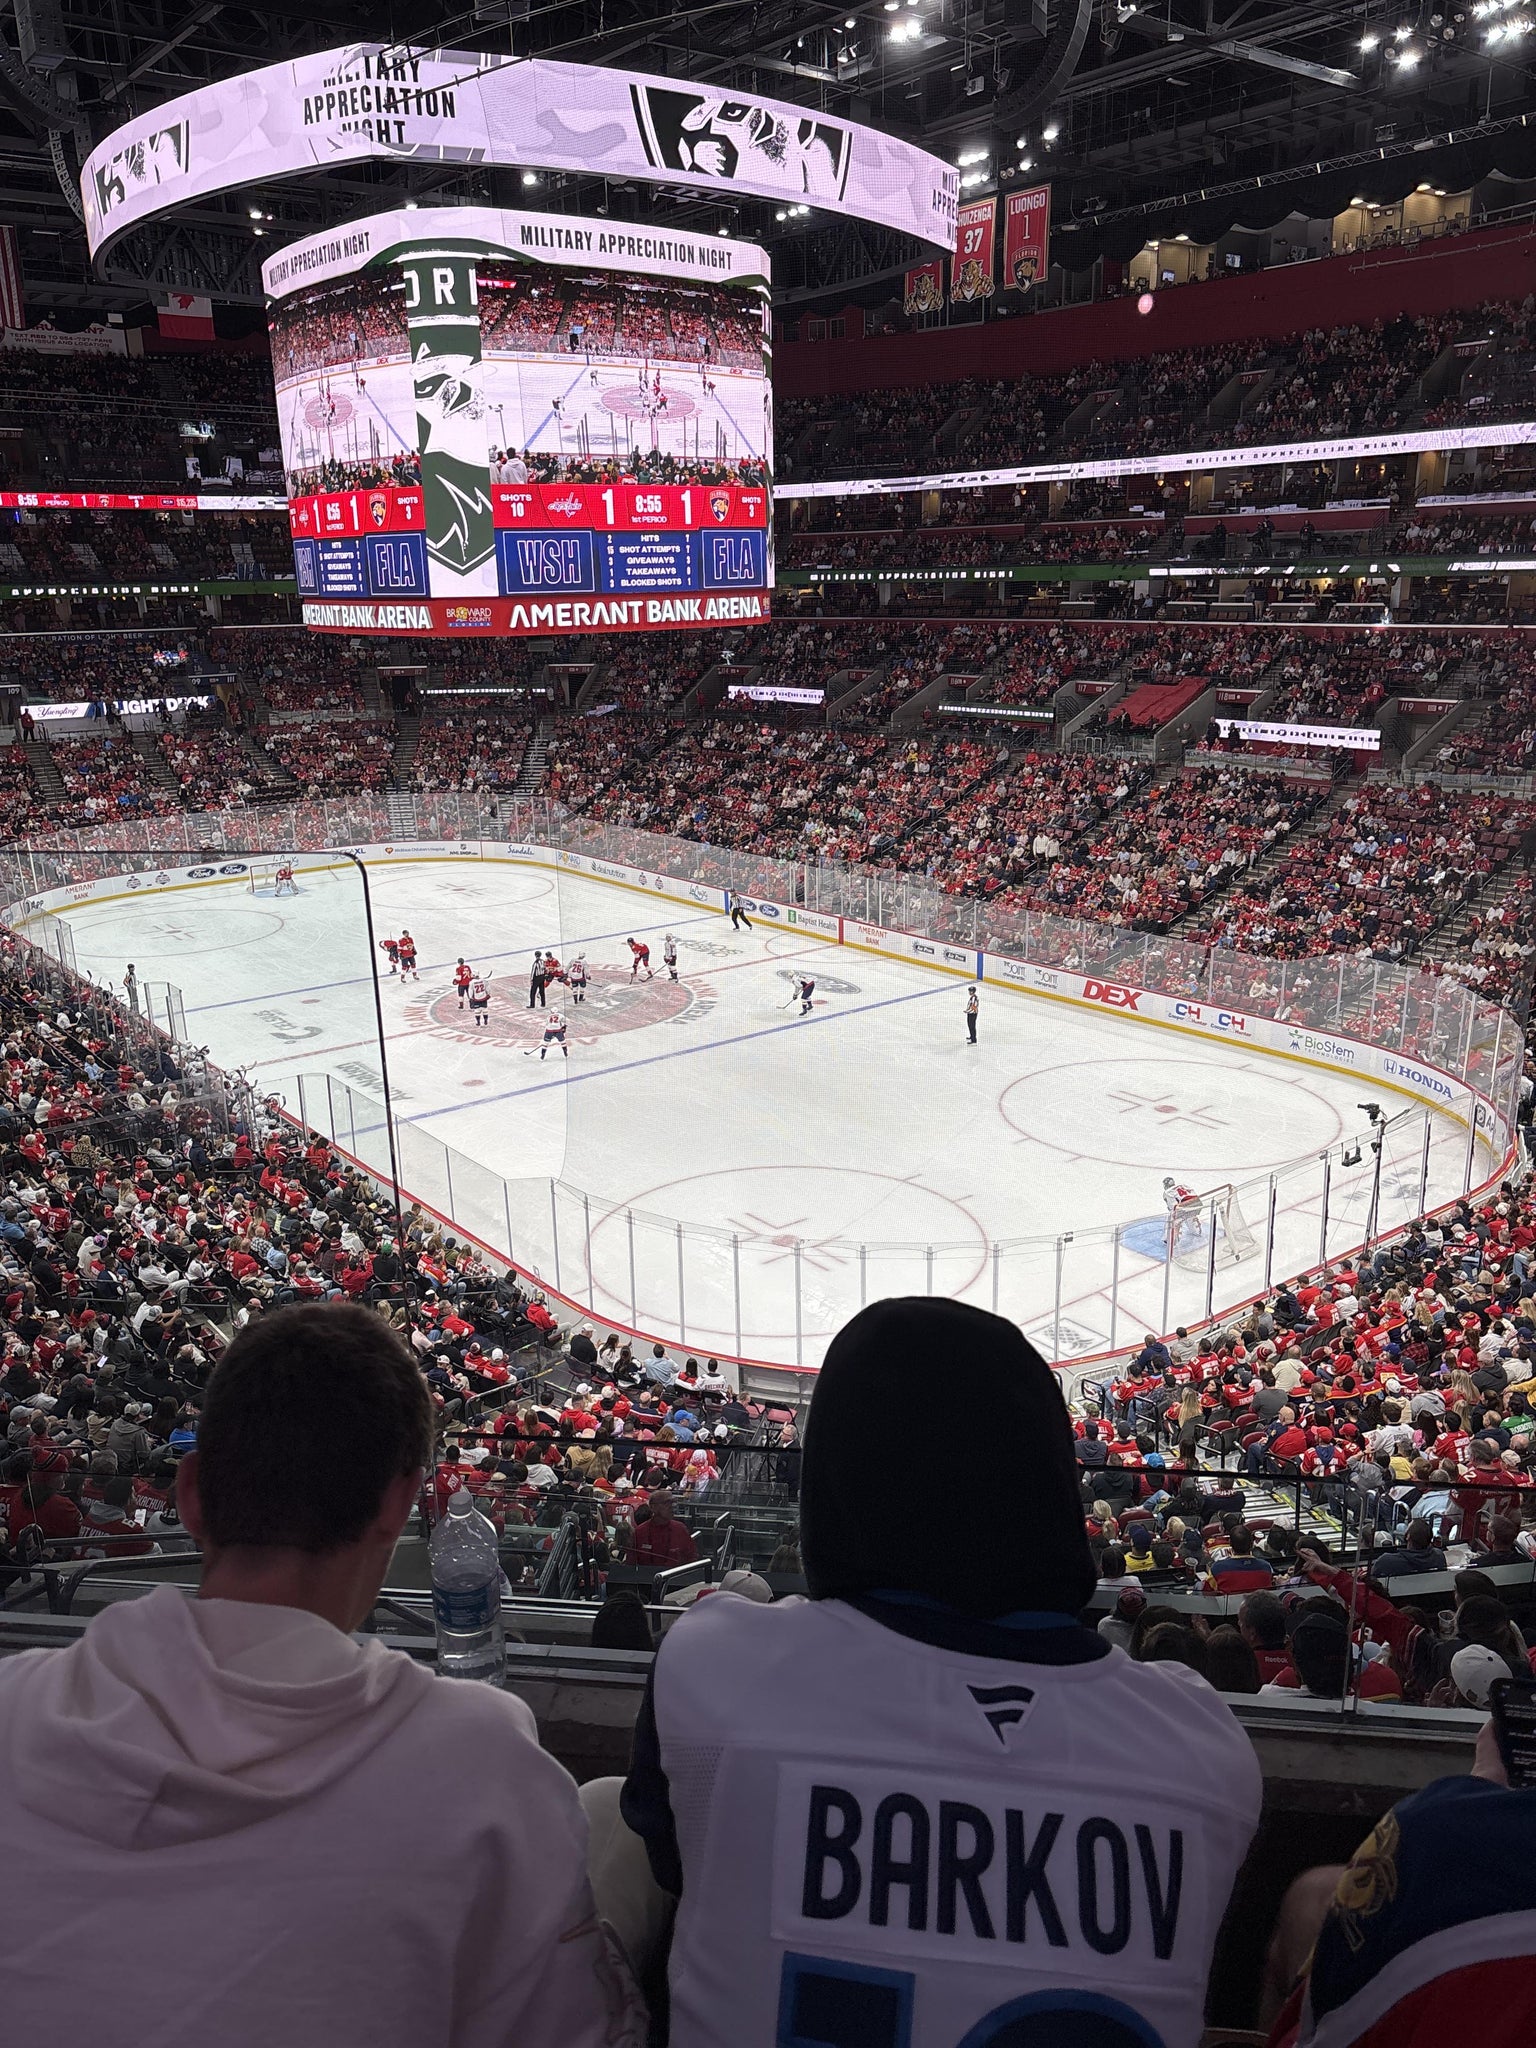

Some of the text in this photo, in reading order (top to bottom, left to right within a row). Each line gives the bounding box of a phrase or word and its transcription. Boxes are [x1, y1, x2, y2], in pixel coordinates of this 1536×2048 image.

[304, 84, 456, 126] APPRECIATION
[1010, 192, 1046, 216] LUONGO
[1022, 214, 1031, 240] 1
[520, 224, 733, 271] MILITARY APPRECIATION NIGHT
[964, 227, 984, 254] 37
[290, 239, 342, 275] APPRECIATION
[343, 231, 370, 258] NIGHT
[730, 367, 744, 376] DEX
[17, 494, 39, 506] 8:55
[500, 494, 532, 502] SHOTS
[602, 489, 615, 525] 1
[635, 494, 662, 513] 8:55
[681, 490, 692, 525] 1
[313, 499, 321, 533] 1
[350, 495, 359, 530] 1
[405, 505, 412, 520] 3
[510, 503, 524, 517] 10
[749, 505, 755, 518] 3
[607, 535, 612, 544] 2
[642, 545, 681, 553] ATTEMPTS
[375, 543, 415, 587] FLA
[517, 538, 755, 584] WSH FLA
[626, 556, 675, 565] GIVEAWAYS
[626, 567, 677, 576] TAKEAWAYS
[621, 577, 656, 587] BLOCKED
[657, 577, 682, 586] SHOTS
[342, 605, 376, 628] BANK
[377, 606, 433, 629] ARENA
[509, 596, 762, 629] AMERANT BANK ARENA
[38, 707, 78, 719] Yuengling
[1400, 703, 1414, 712] 119
[507, 844, 534, 855] Sandals
[192, 867, 212, 878] Ford
[224, 863, 244, 875] Ford
[65, 881, 97, 895] AMERANT
[73, 893, 89, 901] BANK
[762, 905, 776, 915] Ford
[798, 915, 837, 931] Baptist Health
[858, 925, 888, 939] AMERANT
[866, 936, 880, 945] BANK
[572, 965, 582, 973] 26
[474, 985, 485, 994] 22
[1083, 980, 1142, 1011] DEX
[1175, 1003, 1200, 1019] CH
[1218, 1013, 1244, 1030] CH
[1305, 1036, 1355, 1060] BioStem
[1399, 1065, 1454, 1100] HONDA
[1265, 1656, 1288, 1664] Reebok
[802, 1786, 1183, 1960] BARKOV
